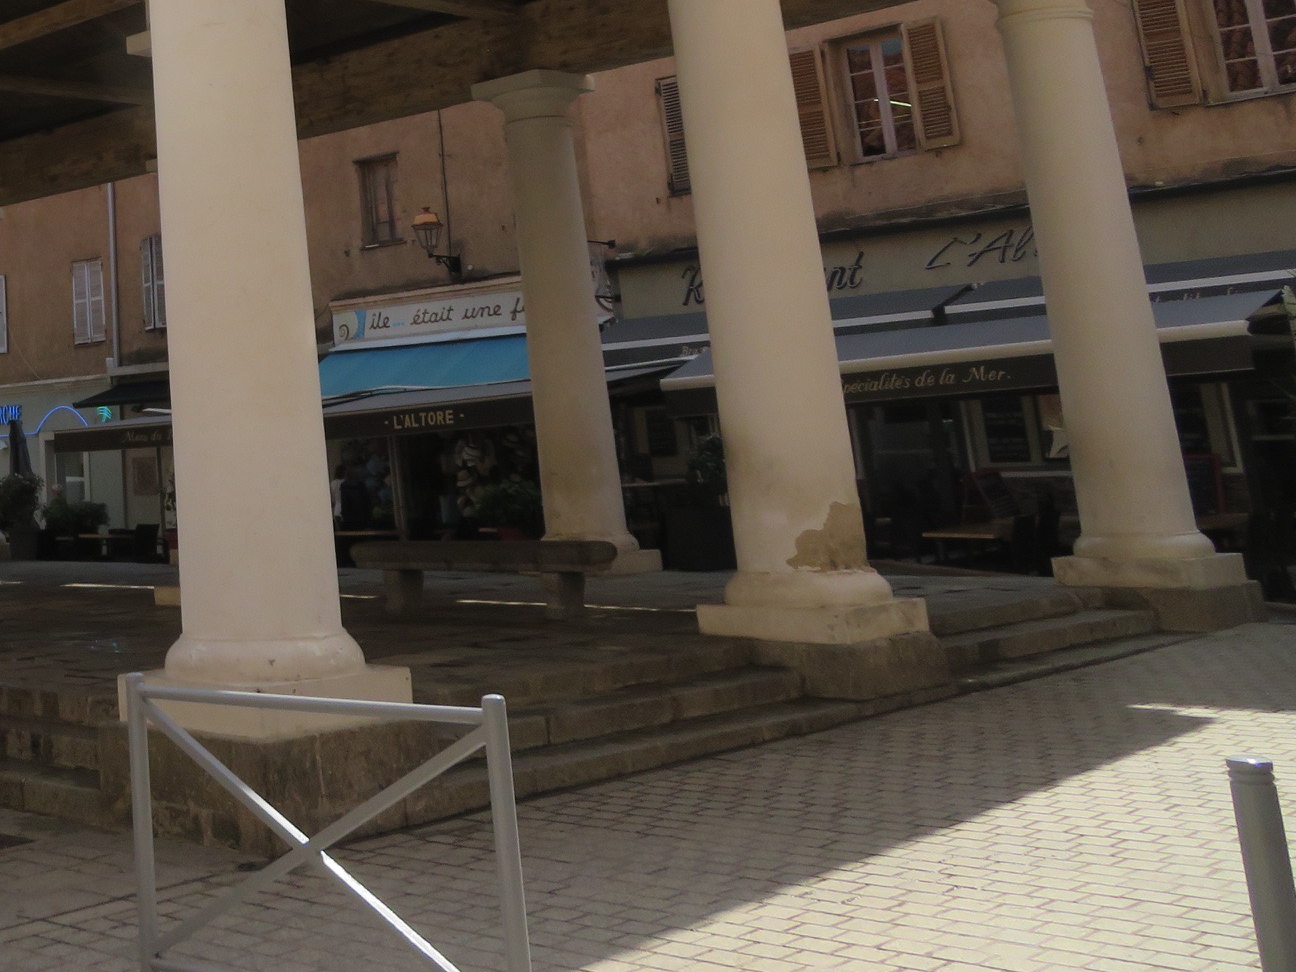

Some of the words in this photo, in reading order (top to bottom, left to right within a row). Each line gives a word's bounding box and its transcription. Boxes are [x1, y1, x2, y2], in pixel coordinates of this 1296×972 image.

[925, 225, 1038, 270] L'Al
[409, 307, 454, 326] était
[461, 303, 502, 320] une
[841, 372, 911, 394] pécialités
[914, 369, 935, 388] de
[939, 367, 956, 385] la
[392, 409, 455, 430] L'ALTORE
